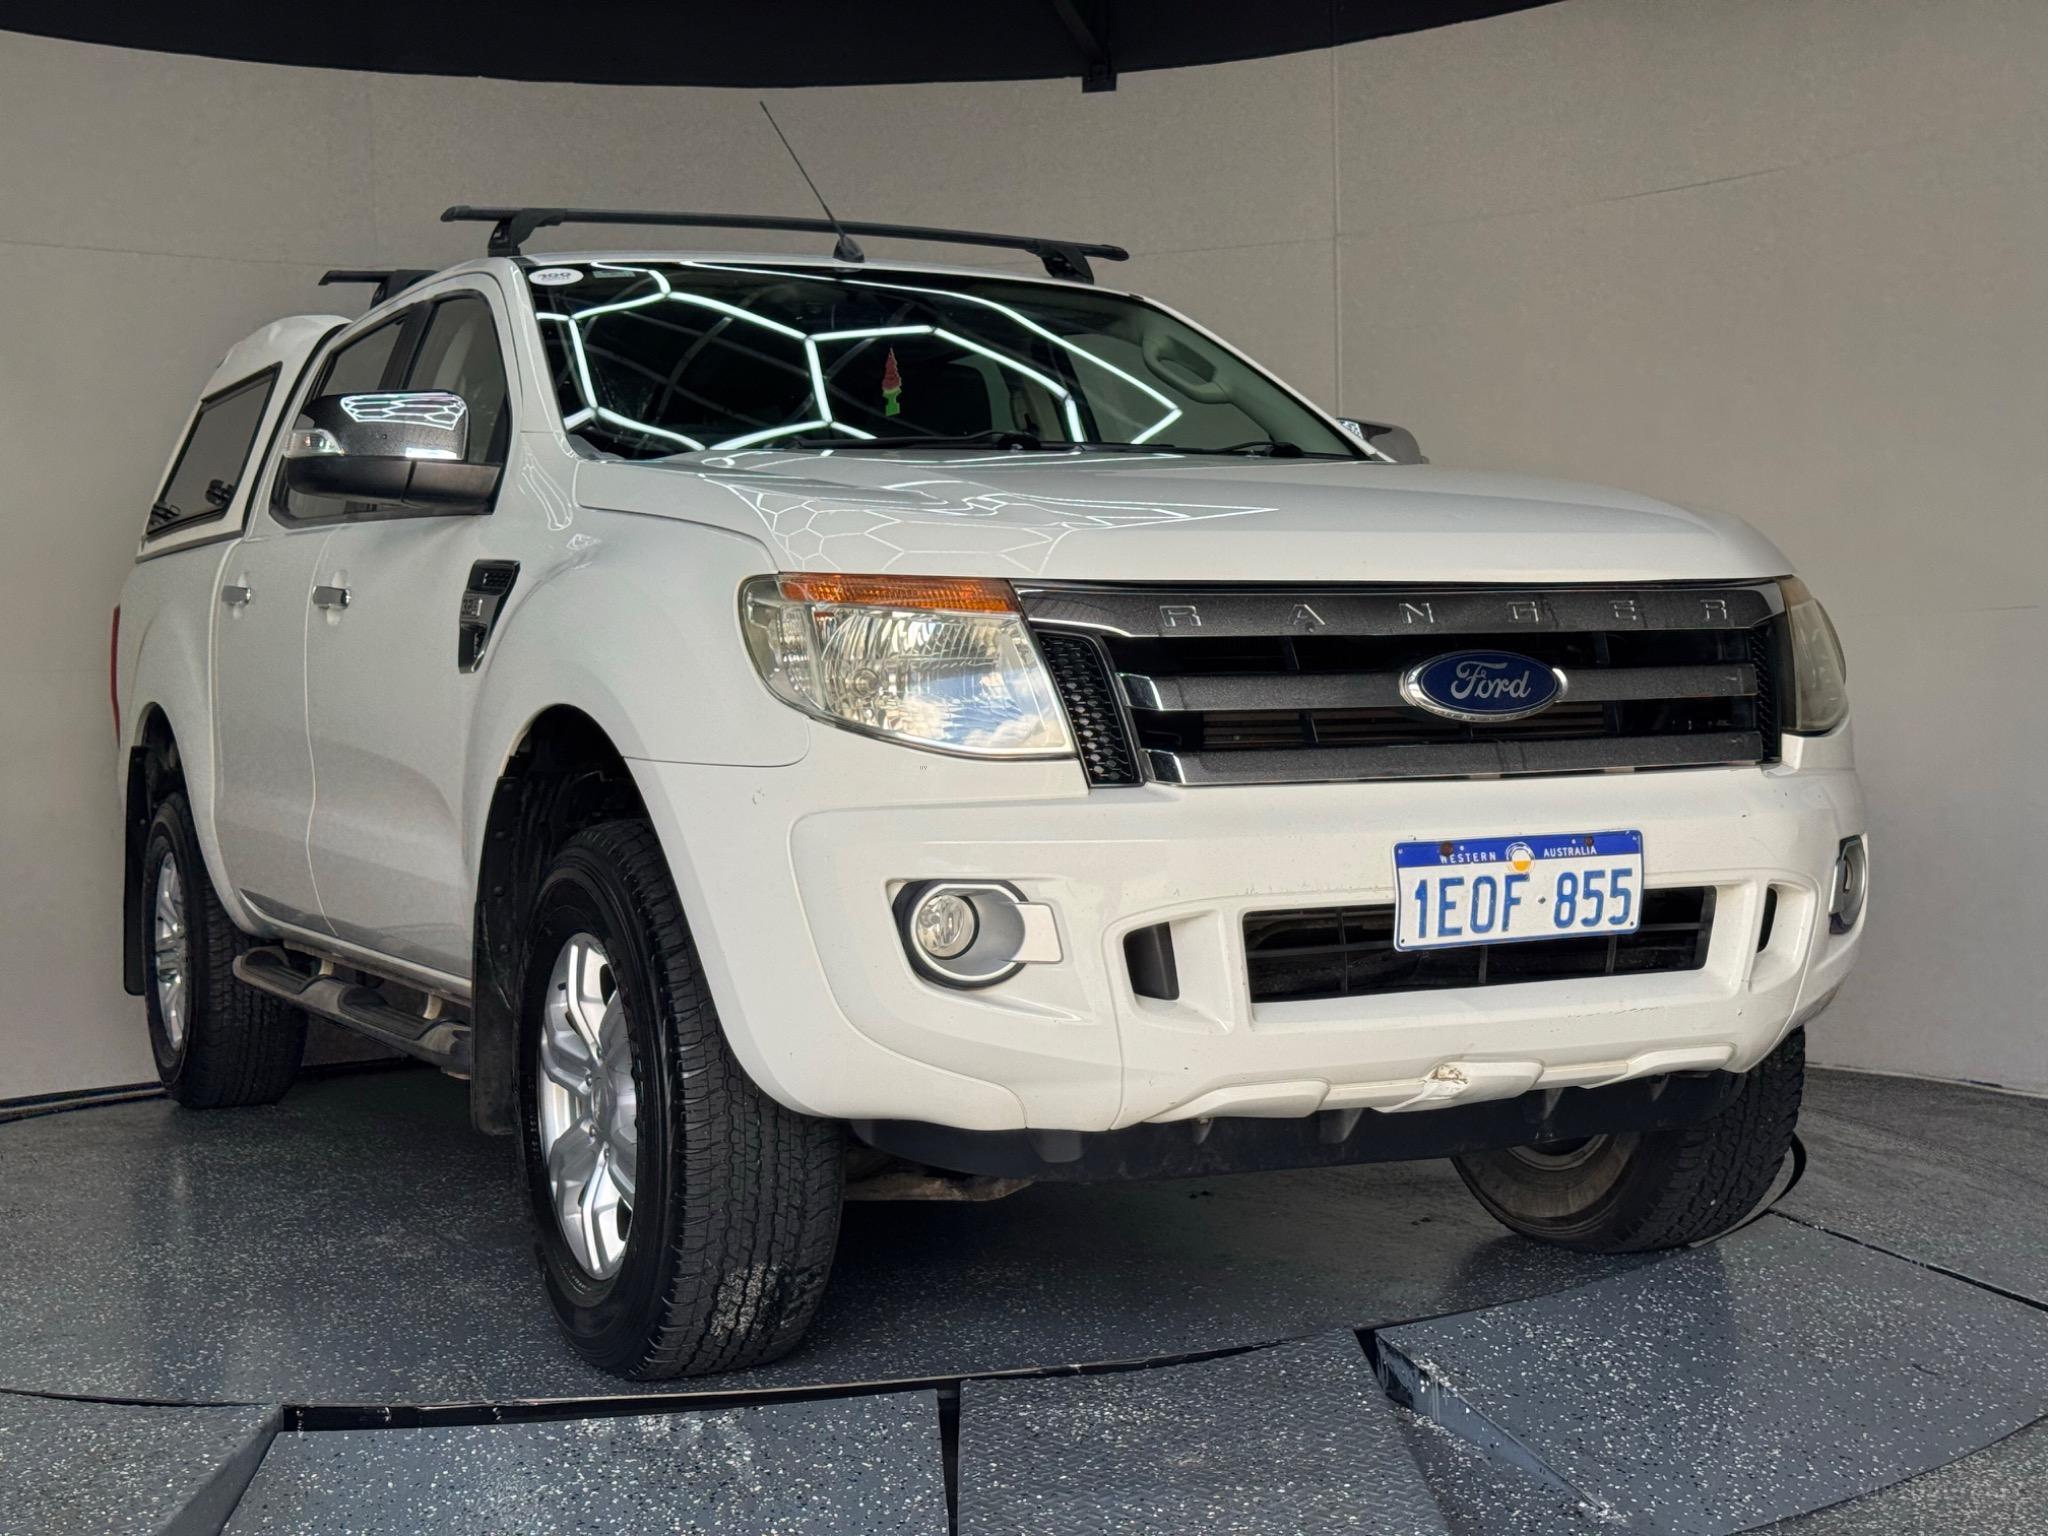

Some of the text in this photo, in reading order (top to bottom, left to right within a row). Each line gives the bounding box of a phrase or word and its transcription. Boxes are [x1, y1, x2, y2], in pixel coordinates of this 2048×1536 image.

[1159, 600, 1727, 627] RANGER
[1451, 661, 1531, 699] Ford
[1440, 845, 1597, 865] WESTERN AUSTRALIA
[1553, 868, 1632, 929] 855
